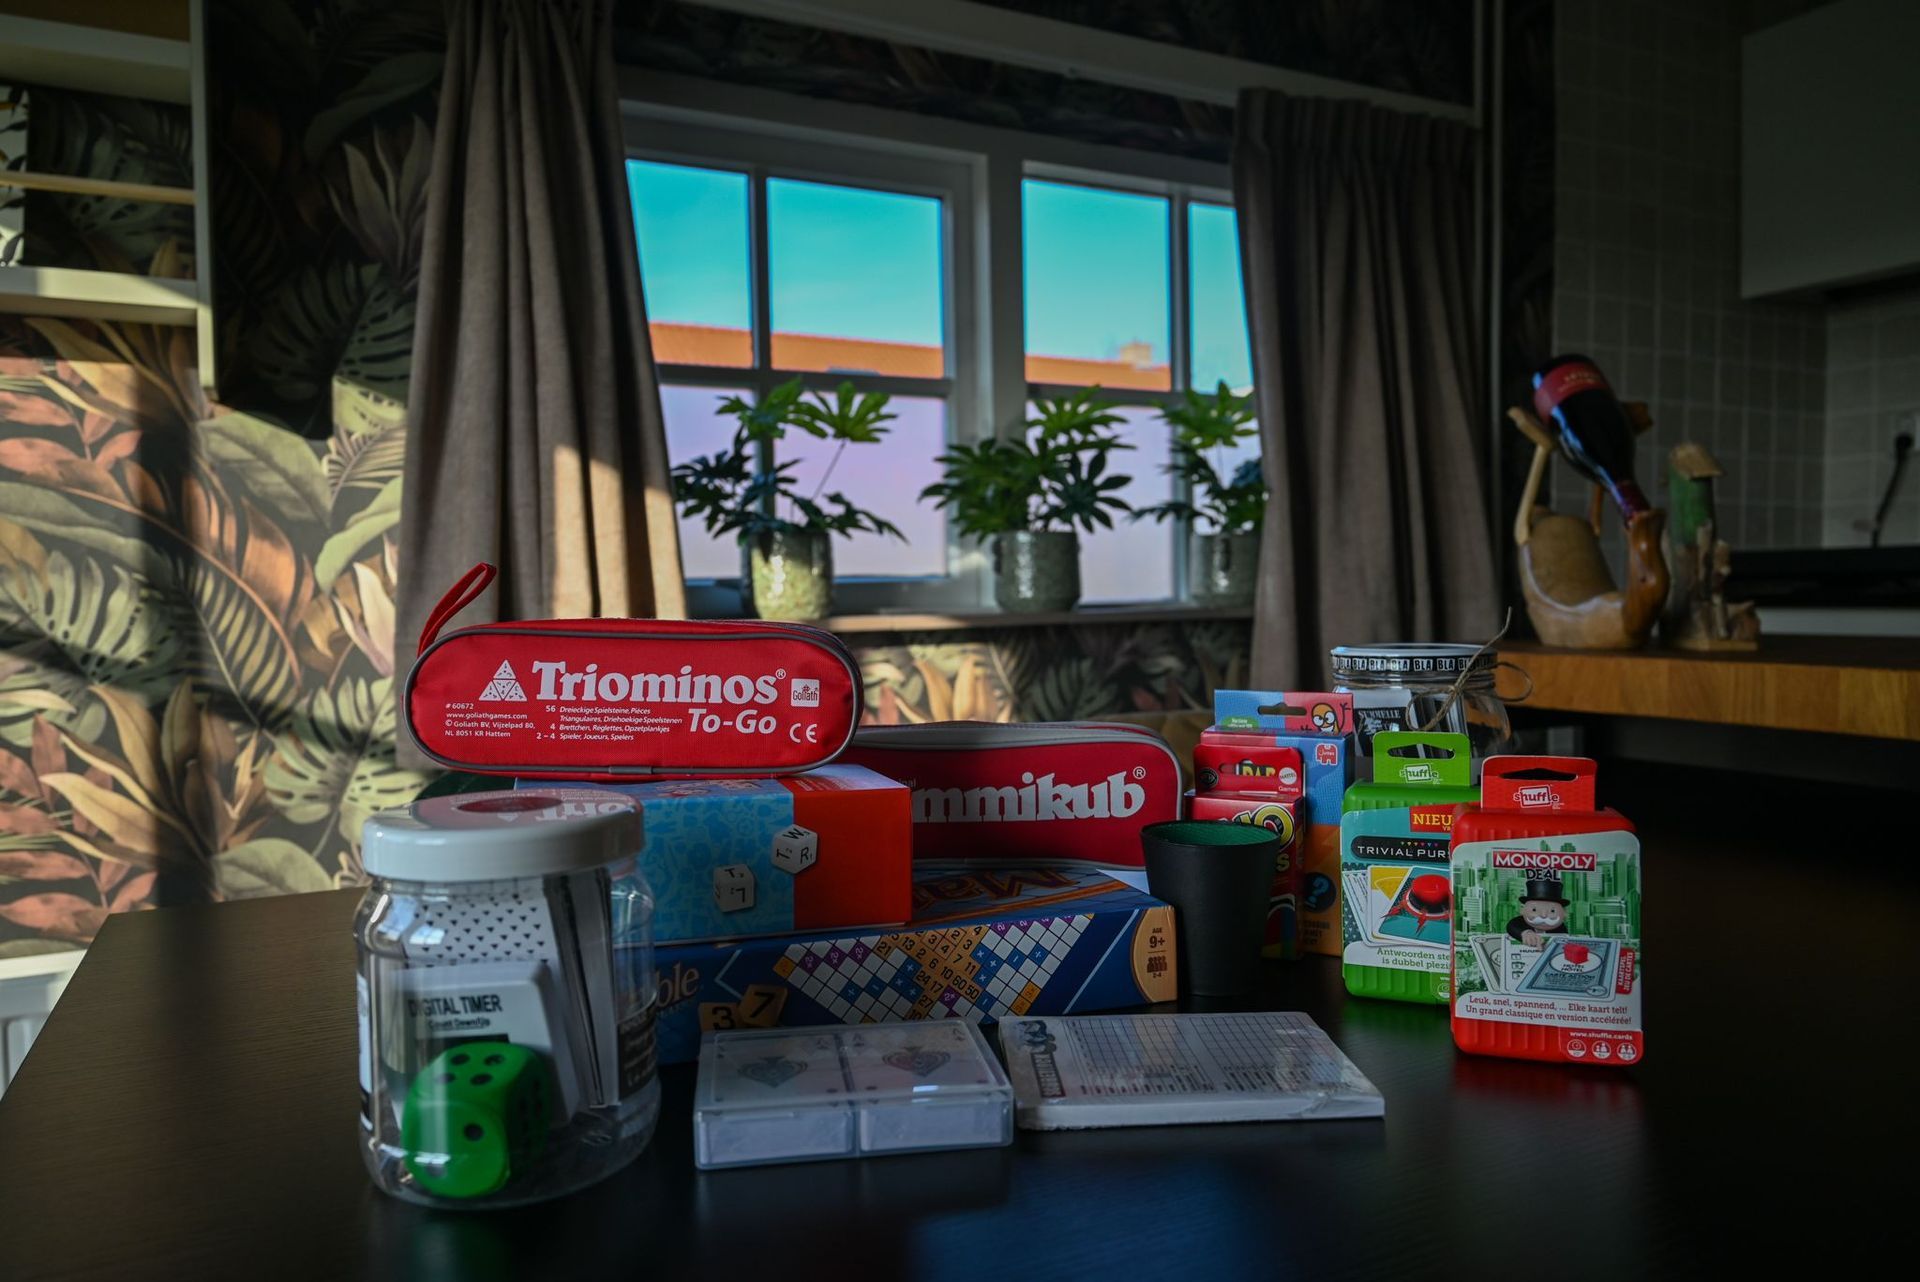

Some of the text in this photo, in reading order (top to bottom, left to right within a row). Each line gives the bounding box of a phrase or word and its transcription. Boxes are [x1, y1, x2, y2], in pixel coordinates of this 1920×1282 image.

[1391, 659, 1408, 670] BLA
[1414, 659, 1433, 670] BLA
[1438, 659, 1454, 670] BLA
[793, 689, 818, 701] Goliath
[446, 711, 528, 720] www.goliathgames.com
[688, 708, 777, 734] To-Go
[1400, 766, 1438, 779] shuffle
[1514, 790, 1559, 802] shuffle
[1357, 845, 1413, 857] TRIVIAL
[1495, 853, 1594, 869] MONOPOLY
[1525, 868, 1561, 881] DEAL
[1149, 935, 1166, 949] 9+
[1377, 947, 1435, 959] Antwoorden
[1392, 958, 1424, 967] dubbel
[409, 994, 502, 1018] DGITAL TIMER
[754, 991, 774, 1018] 7
[1470, 995, 1490, 1005] Leuk,
[1493, 998, 1511, 1007] snel,
[1568, 1003, 1586, 1011] Elke
[1588, 1004, 1610, 1013] kaart
[1466, 1005, 1477, 1013] Un
[1479, 1007, 1503, 1016] grand
[1505, 1009, 1543, 1020] classique
[1557, 1014, 1588, 1022] version
